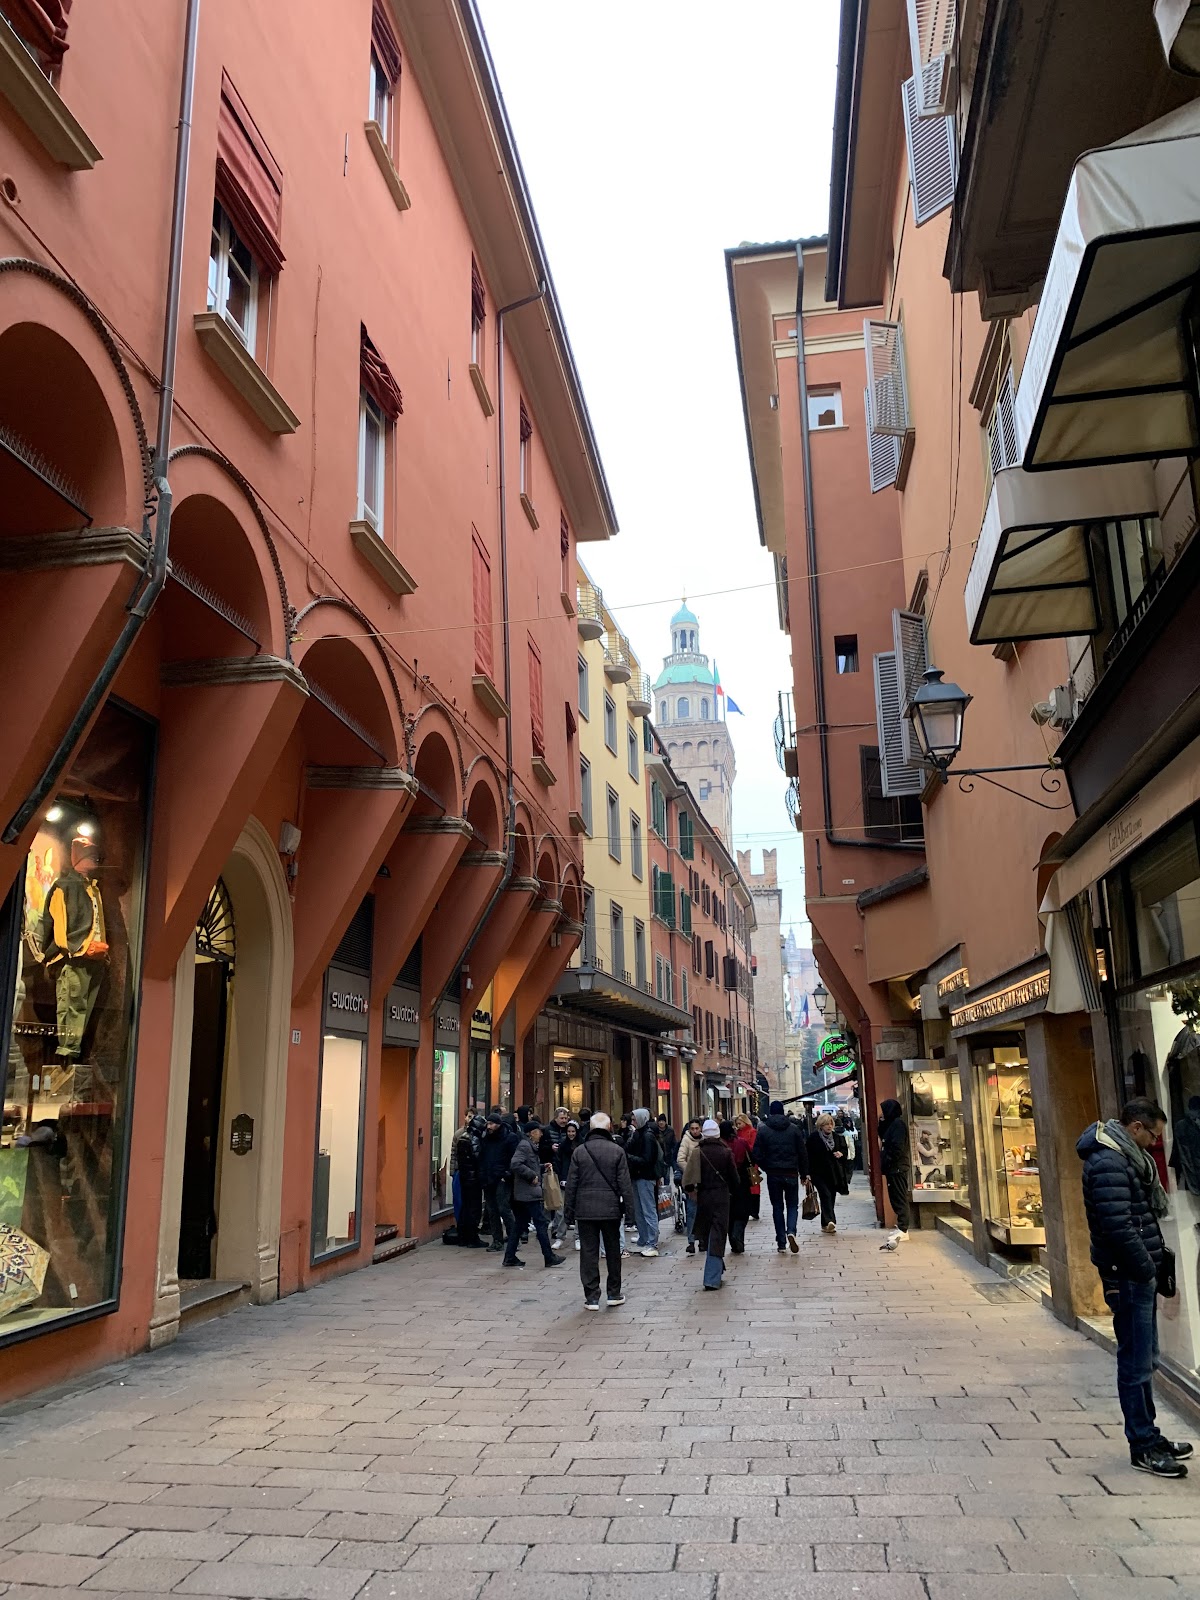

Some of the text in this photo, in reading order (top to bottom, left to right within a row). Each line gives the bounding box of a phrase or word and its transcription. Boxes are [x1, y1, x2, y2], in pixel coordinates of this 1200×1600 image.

[332, 991, 363, 1013] swatch
[391, 1005, 415, 1022] swatch
[439, 1016, 458, 1031] swatch
